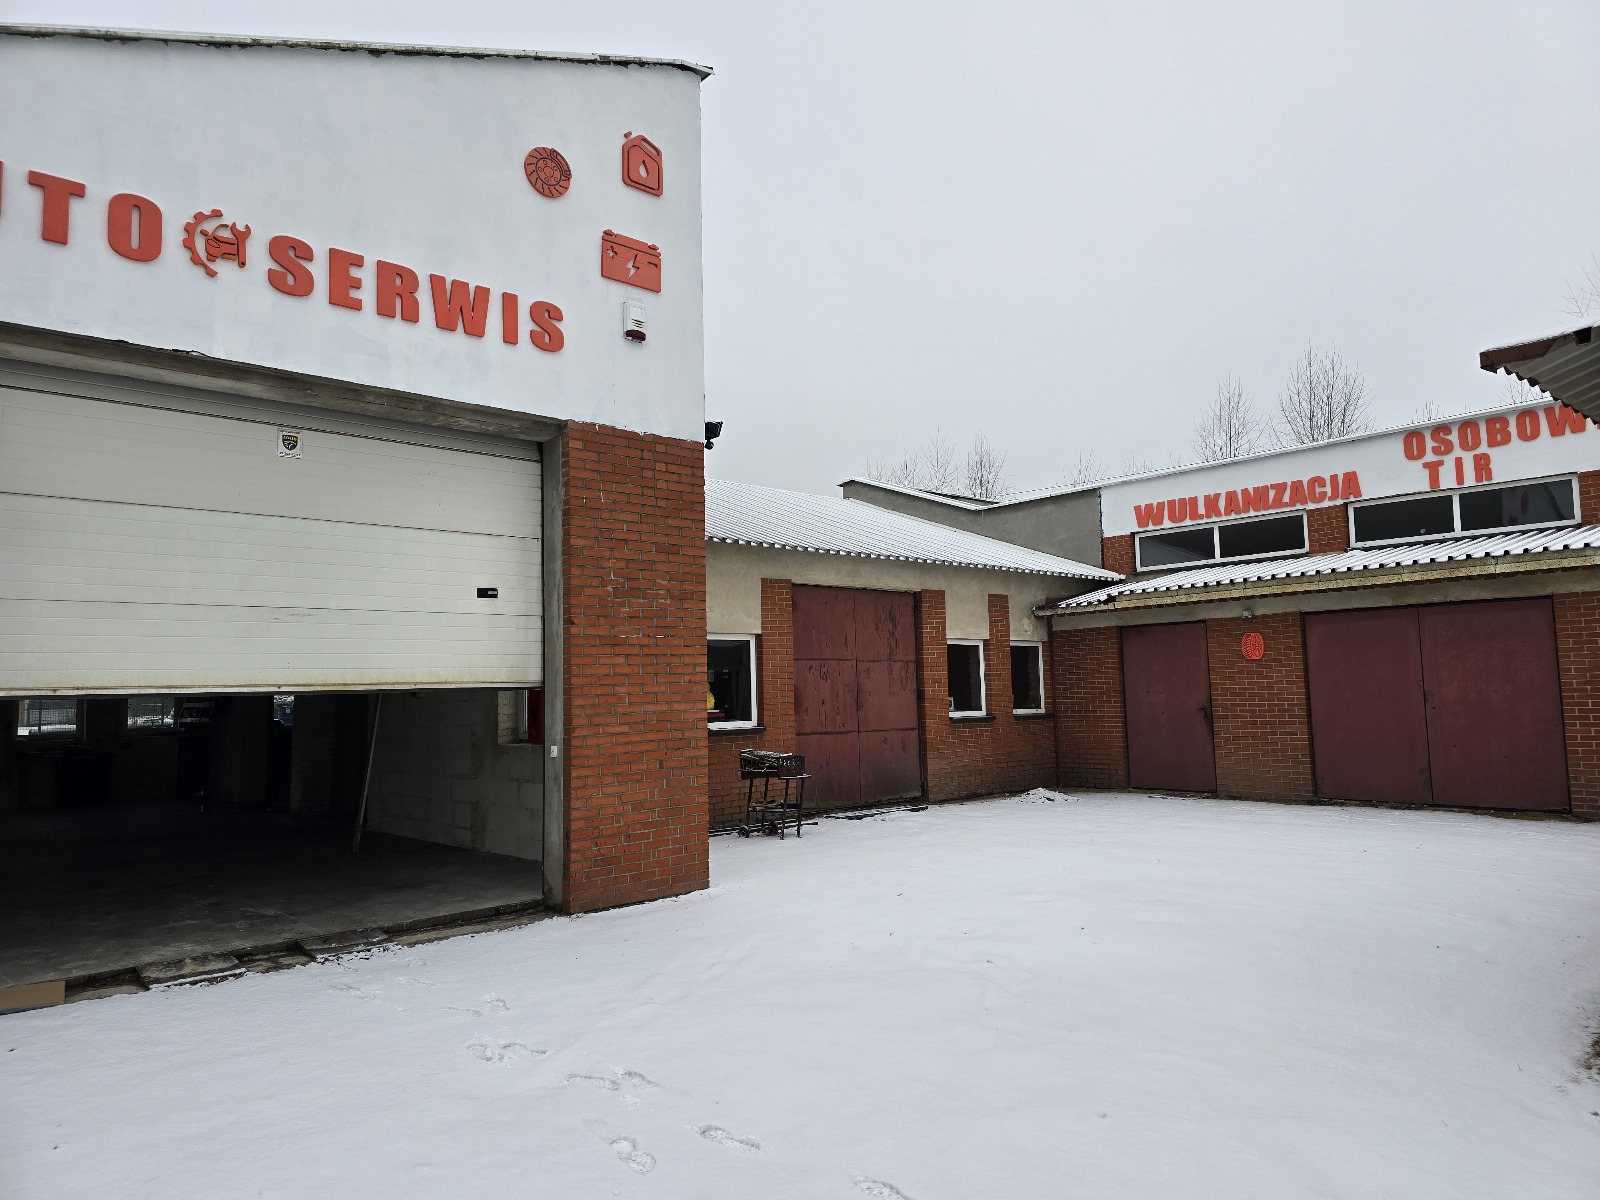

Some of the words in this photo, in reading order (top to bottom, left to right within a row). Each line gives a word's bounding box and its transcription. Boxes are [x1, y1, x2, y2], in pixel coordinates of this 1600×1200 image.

[0, 160, 163, 262] TO
[267, 235, 565, 353] SERWIS
[1403, 404, 1600, 462] OSOBOW
[1133, 471, 1363, 529] WULKANIZACJA
[1422, 452, 1493, 490] TIR
